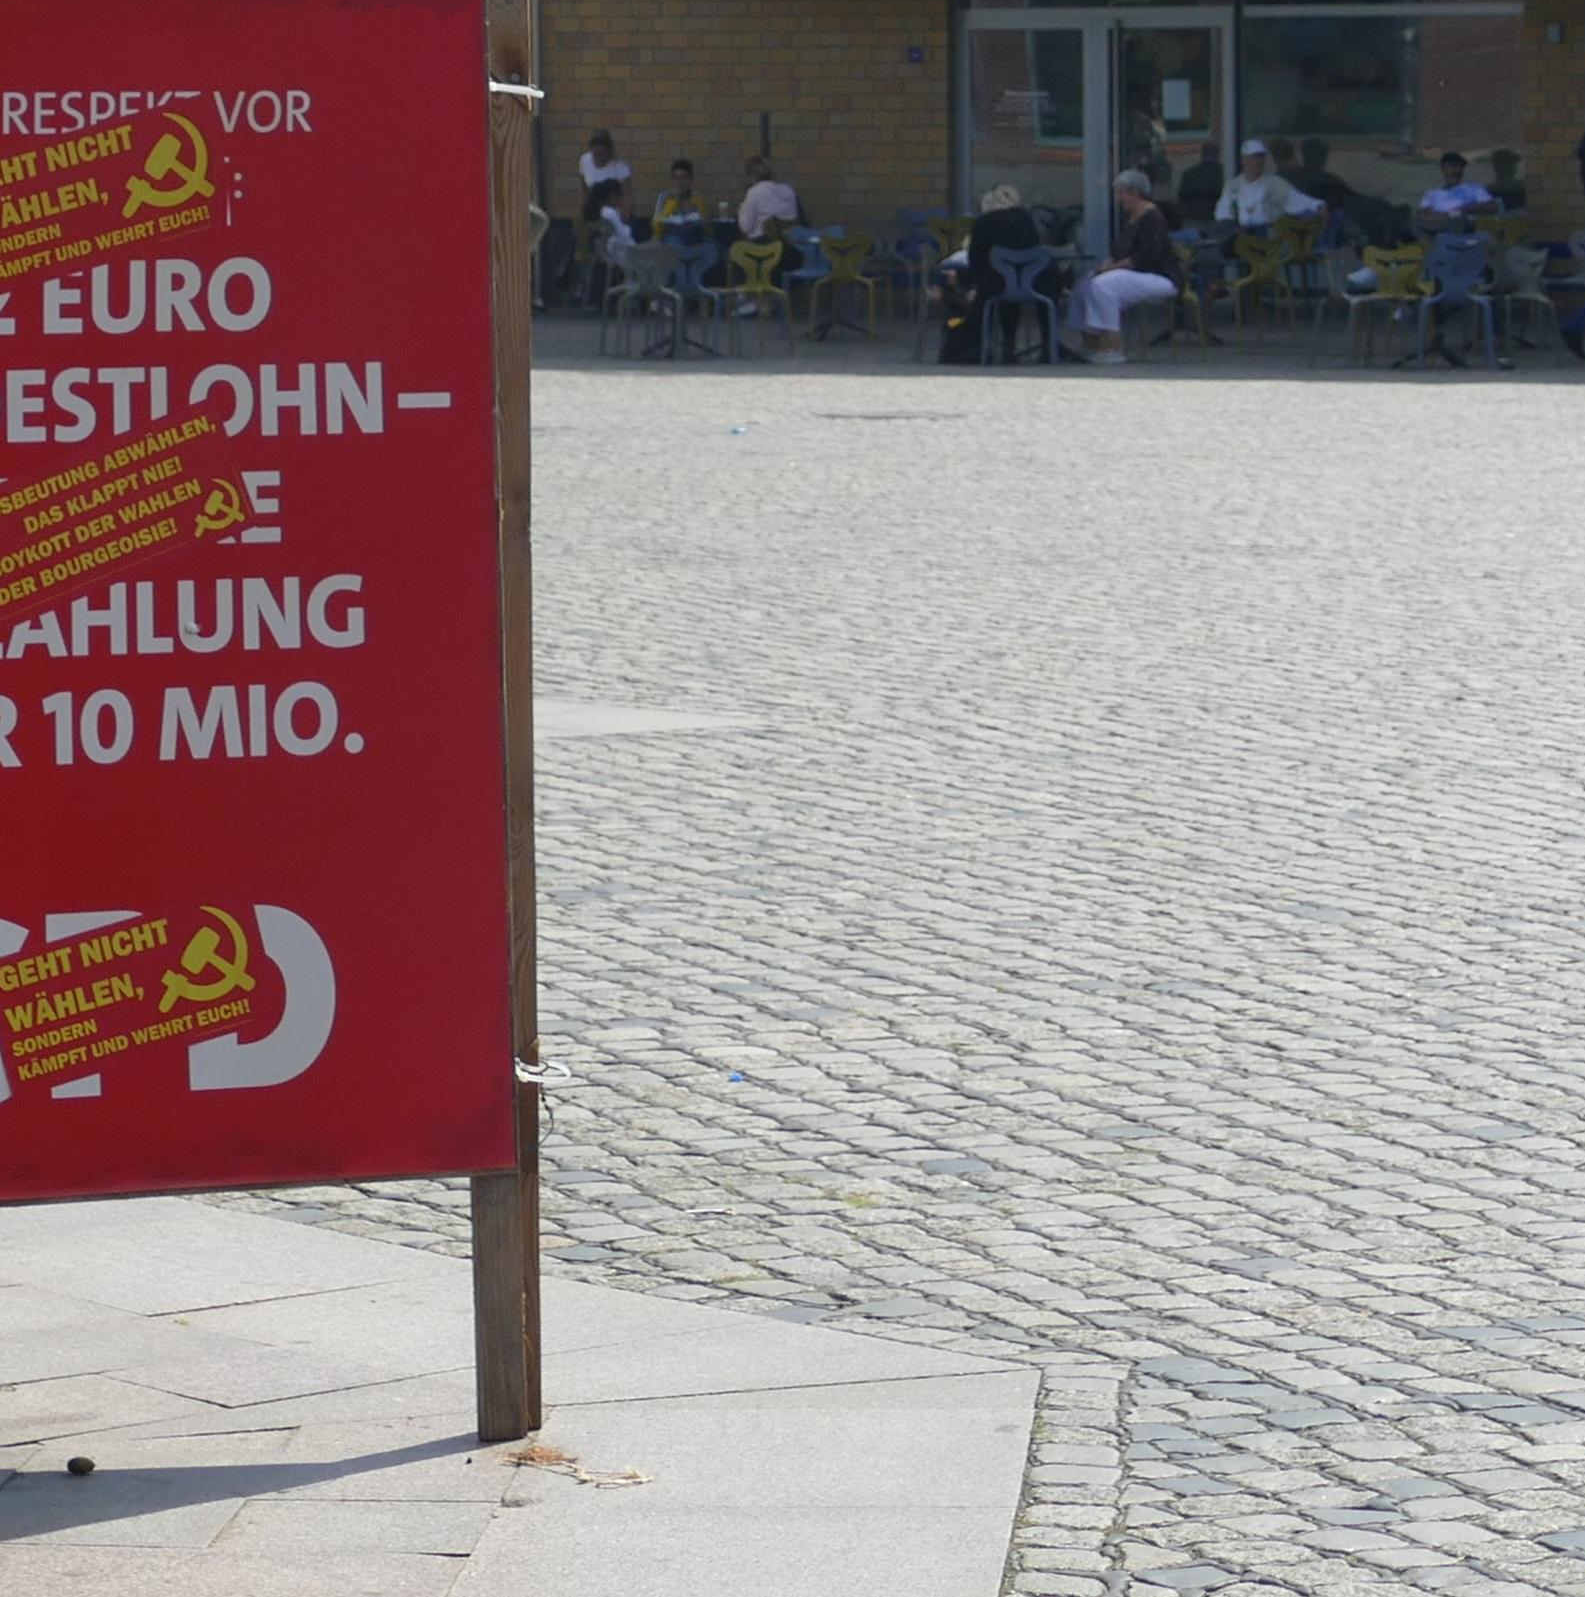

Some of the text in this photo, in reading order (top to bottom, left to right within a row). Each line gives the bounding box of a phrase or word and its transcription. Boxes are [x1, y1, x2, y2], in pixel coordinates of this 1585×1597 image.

[213, 90, 313, 133] VOR
[44, 124, 133, 172] NICHT
[55, 240, 92, 262] UND
[94, 220, 156, 251] WEHRT
[158, 205, 211, 233] EUCH!
[41, 256, 273, 336] EURO
[103, 415, 217, 473] ABWÄHLEN,
[23, 456, 183, 535] DAS KLAPPT NIE!
[76, 514, 116, 544] DER
[118, 478, 202, 525] WAHLEN
[39, 518, 178, 588] BOURGEOISIE!
[42, 688, 134, 767] 10
[159, 681, 364, 762] MIO.
[81, 918, 169, 967] NICHT
[3, 972, 144, 1033] WÄHLEN,
[11, 1018, 98, 1057] SONDERN
[18, 998, 251, 1082] KÄMPFT UND WEHRT EUCH!
